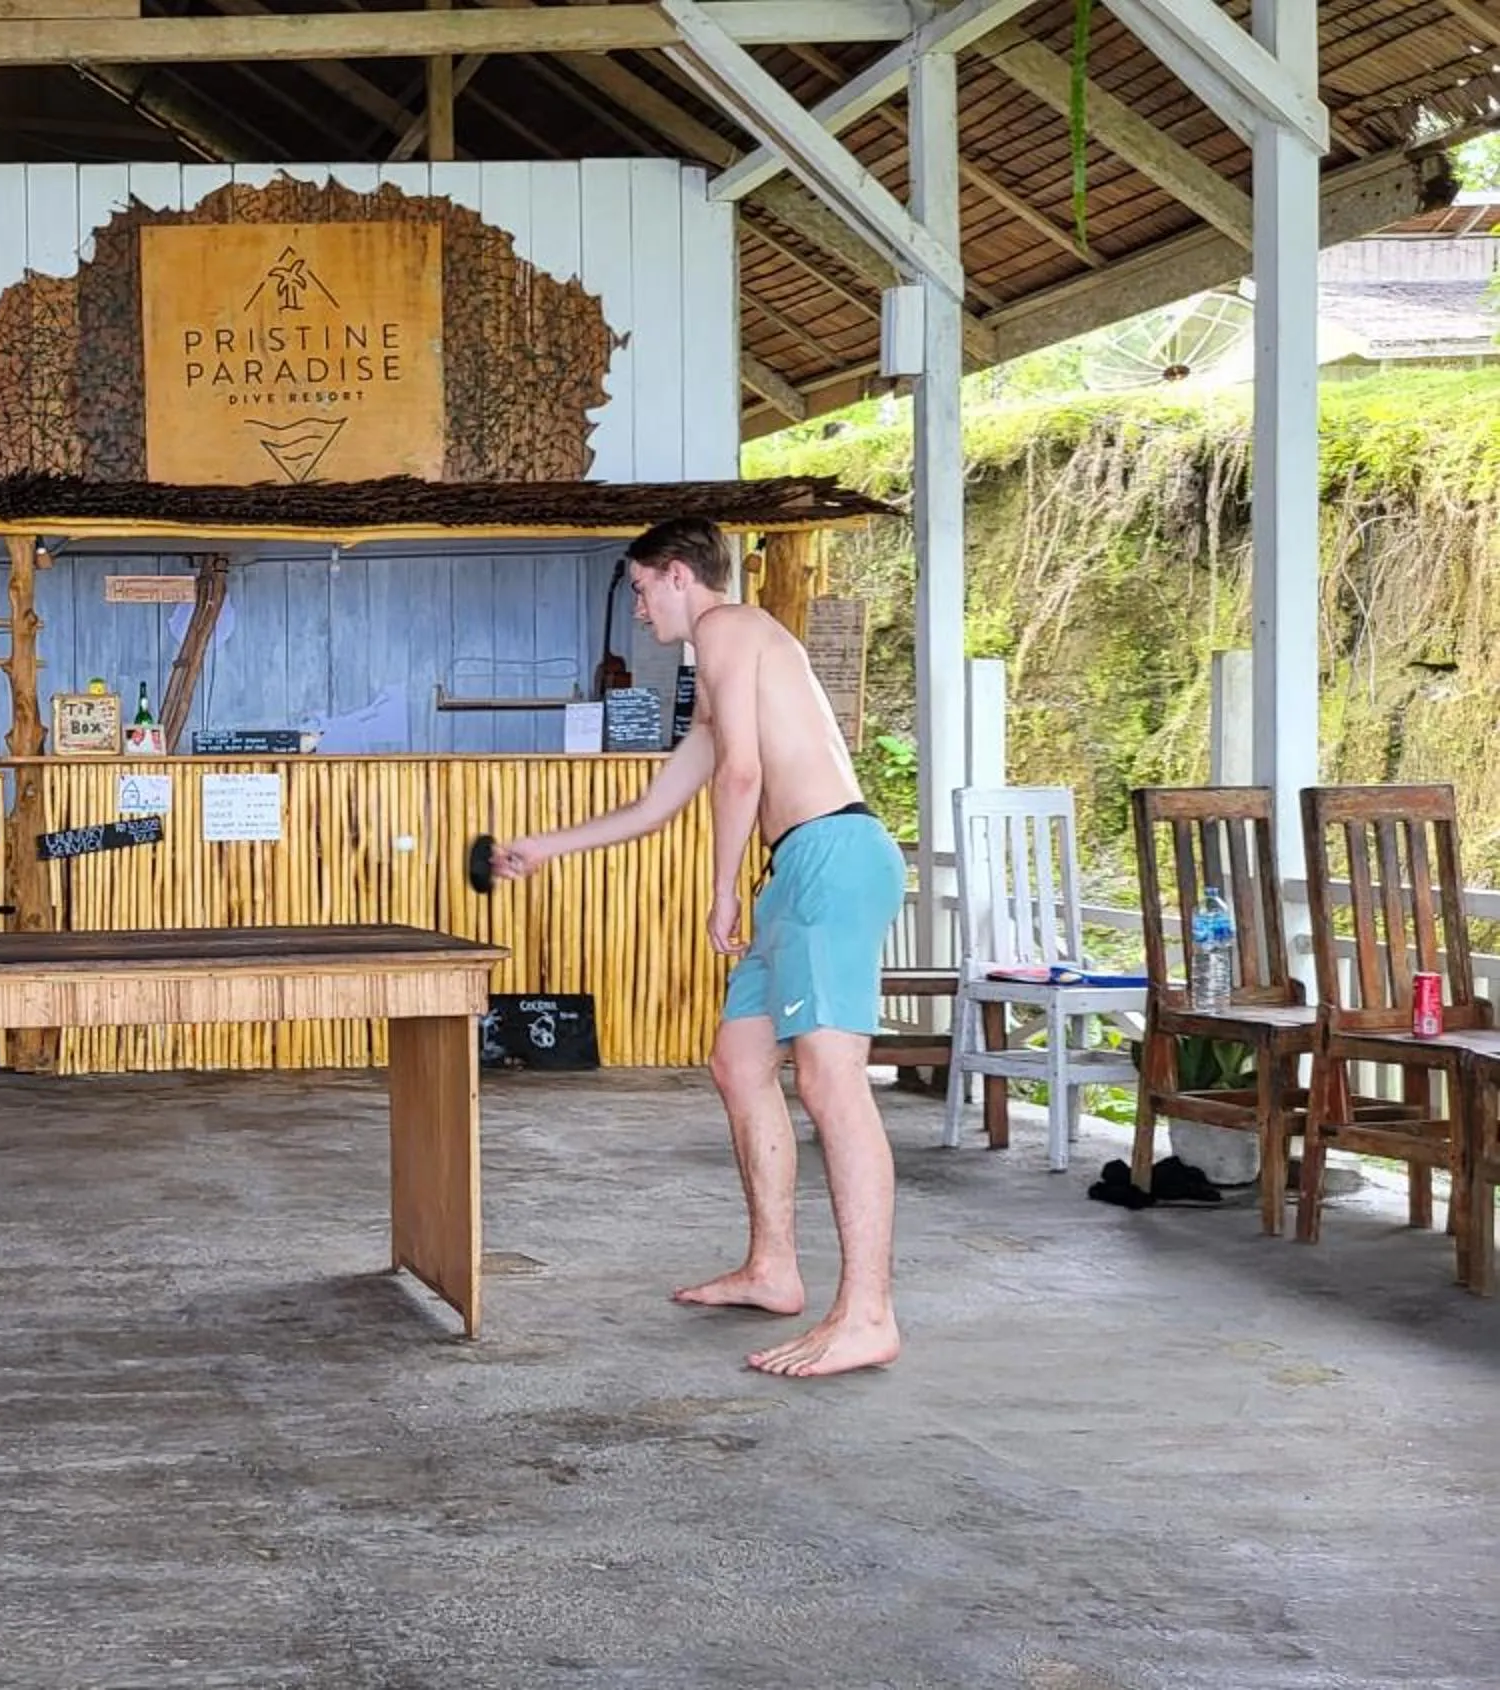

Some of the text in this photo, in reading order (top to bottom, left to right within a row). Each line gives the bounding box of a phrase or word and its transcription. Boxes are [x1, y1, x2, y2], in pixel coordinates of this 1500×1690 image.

[184, 323, 400, 355] PRISTINE
[186, 355, 401, 388] PARADISE
[229, 390, 364, 405] DIVE RESORT
